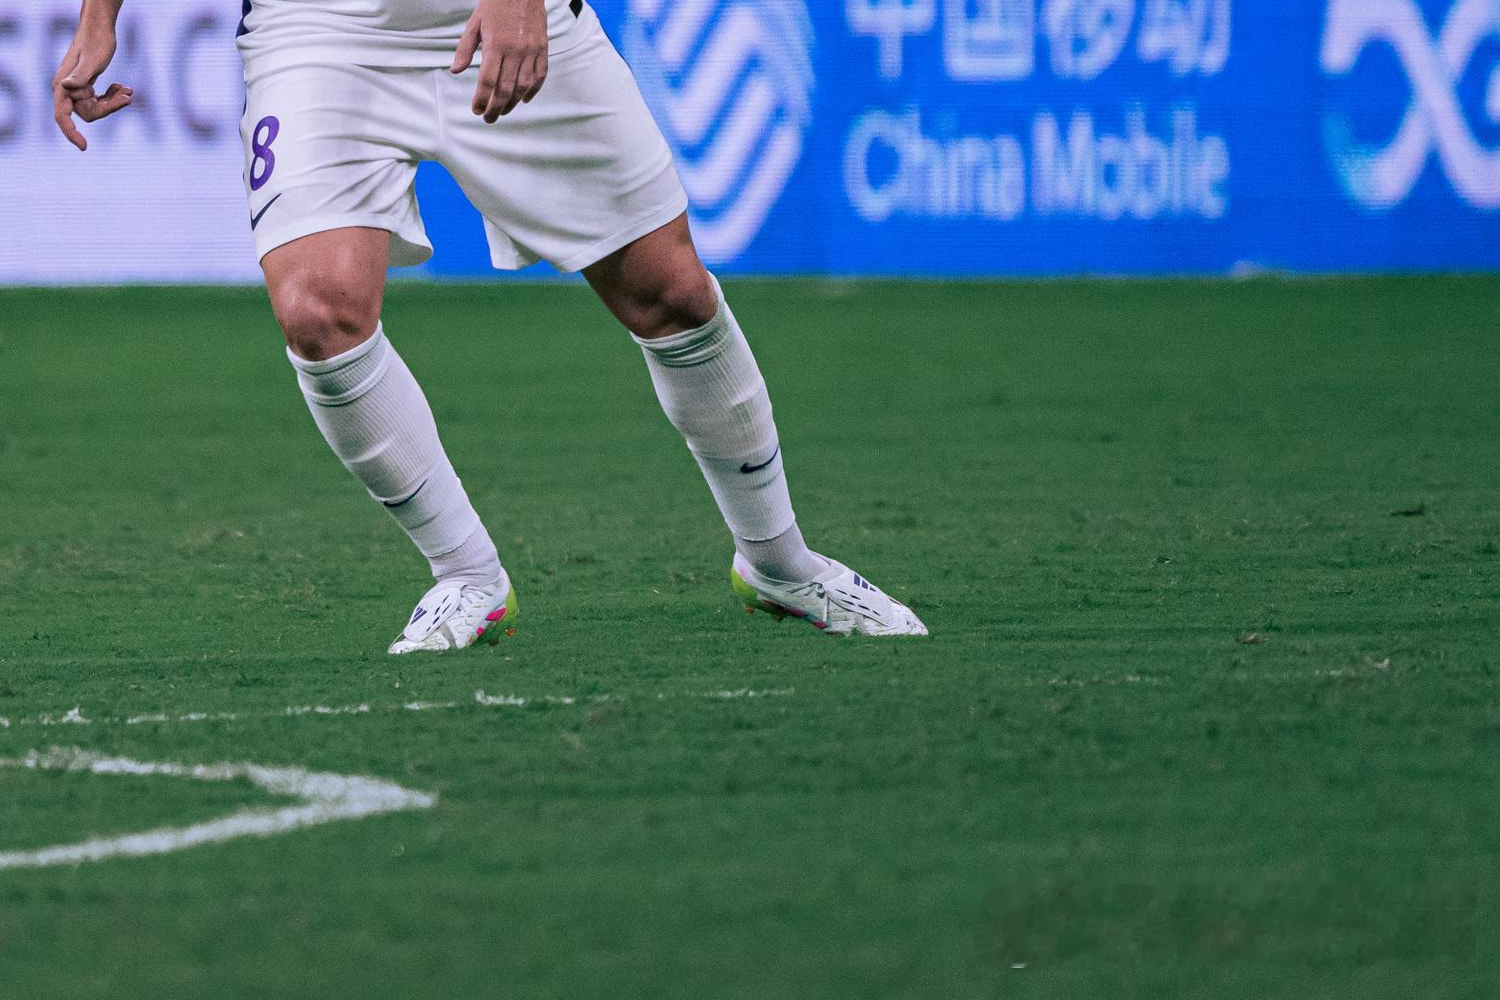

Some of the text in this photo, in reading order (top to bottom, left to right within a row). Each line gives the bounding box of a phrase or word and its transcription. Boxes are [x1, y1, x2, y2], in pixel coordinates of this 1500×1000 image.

[250, 115, 280, 191] 8
[843, 101, 1231, 221] China Mobile
